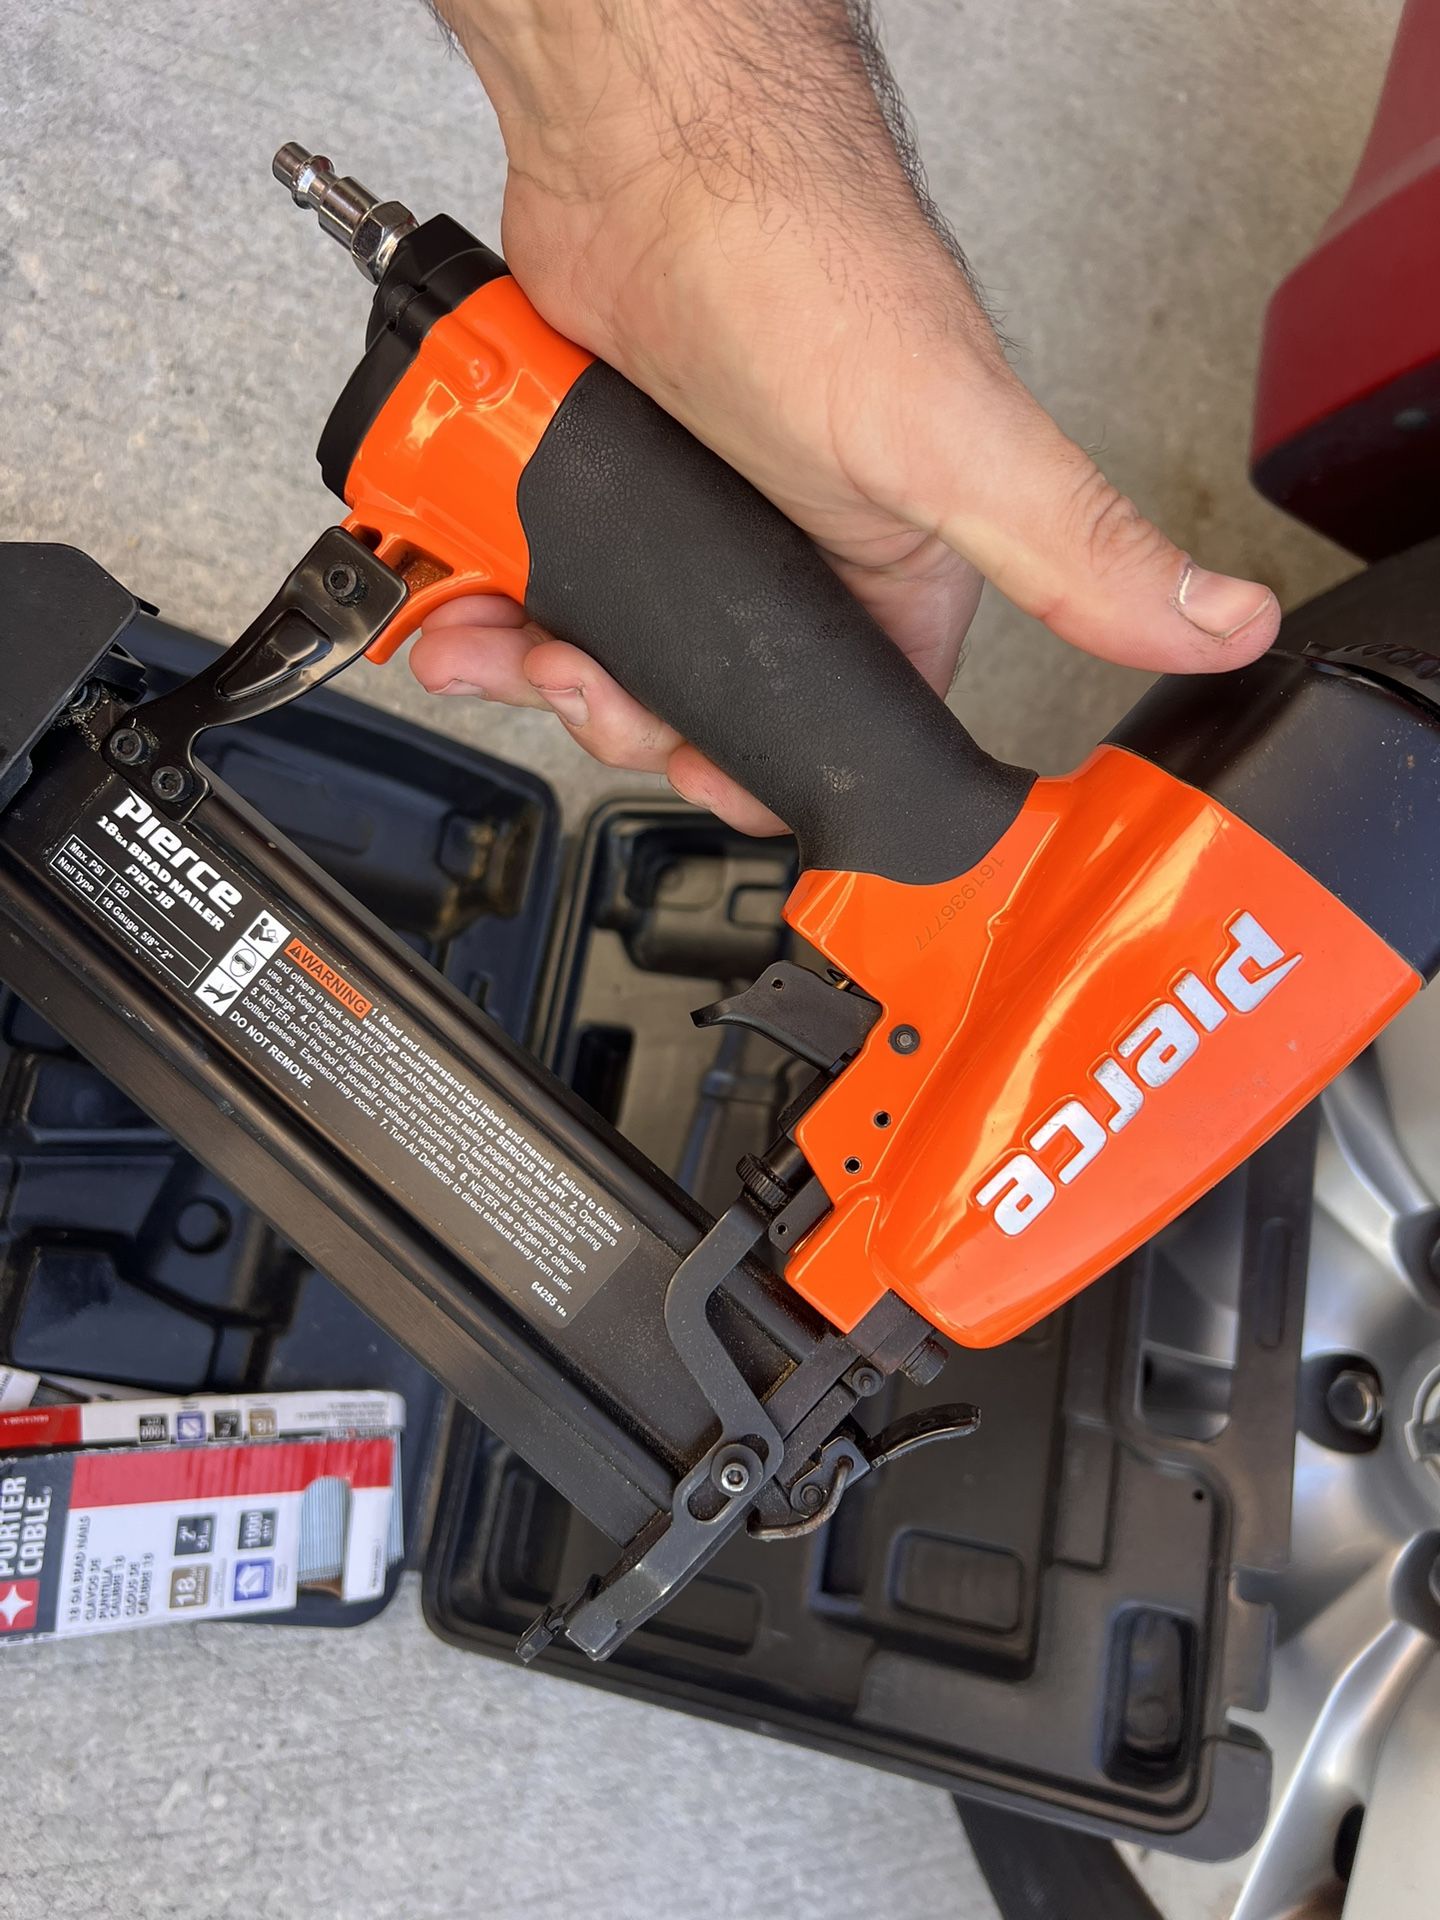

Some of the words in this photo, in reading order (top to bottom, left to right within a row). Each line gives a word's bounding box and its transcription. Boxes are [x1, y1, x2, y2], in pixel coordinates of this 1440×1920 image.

[57, 856, 77, 876] Nail
[74, 870, 95, 893] Type
[69, 842, 88, 864] Max.
[88, 859, 106, 877] PSI
[113, 788, 243, 917] Pierce
[113, 882, 130, 899] 120
[124, 863, 176, 910] PRC-18
[127, 841, 172, 883] BRAD
[168, 878, 225, 931] NAILER
[102, 896, 115, 909] 18
[112, 906, 140, 936] Gauge,
[914, 856, 1005, 951] 161936777
[297, 950, 367, 1014] WARNING
[228, 1010, 248, 1029] DO
[245, 1024, 272, 1048] NOT
[267, 1044, 314, 1089] REMOVE.
[975, 911, 1303, 1236] Pierce
[241, 995, 271, 1023] bottled
[266, 1020, 297, 1049] gasses.
[299, 1047, 338, 1084] Explosion
[335, 1080, 356, 1100] may
[353, 1096, 378, 1120] occur.
[379, 1117, 389, 1130] 7.
[389, 1124, 408, 1146] Turn
[405, 1142, 420, 1156] Air
[417, 1152, 455, 1186] Deflector
[452, 1182, 462, 1195] to
[460, 1192, 485, 1215] direct
[482, 1211, 516, 1242] exhaust
[512, 1238, 536, 1261] away
[533, 1256, 554, 1277] from
[552, 1273, 573, 1295] user.
[249, 986, 260, 998] 5.
[258, 993, 291, 1025] NEVER
[286, 1021, 311, 1042] point
[307, 1037, 323, 1053] the
[320, 1049, 339, 1067] tool
[335, 1064, 348, 1075] at
[342, 1071, 379, 1101] yourself
[375, 1098, 387, 1109] or
[384, 1106, 411, 1131] others
[408, 1126, 419, 1139] in
[417, 1135, 438, 1156] work
[436, 1153, 456, 1174] area.
[459, 1172, 469, 1184] 6.
[467, 1179, 501, 1211] NEVER
[497, 1207, 514, 1224] use
[512, 1221, 543, 1250] oxygen
[541, 1246, 553, 1257] or
[550, 1255, 574, 1276] other
[258, 978, 297, 1015] discharge.
[299, 1014, 309, 1025] 4.
[308, 1021, 337, 1049] Choice
[334, 1046, 348, 1057] of
[343, 1052, 382, 1089] triggering
[379, 1085, 412, 1114] method
[408, 1109, 418, 1121] is
[416, 1116, 455, 1154] important.
[457, 1152, 483, 1179] Check
[481, 1175, 513, 1204] manual
[509, 1199, 524, 1214] for
[521, 1210, 559, 1248] triggering
[557, 1243, 587, 1274] options.
[266, 967, 283, 986] use.
[285, 984, 295, 996] 3.
[294, 991, 317, 1014] Keep
[315, 1010, 344, 1037] fingers
[340, 1033, 370, 1057] AWAY
[365, 1054, 386, 1075] from
[383, 1070, 411, 1096] trigger
[408, 1093, 432, 1116] when
[429, 1112, 446, 1128] not
[443, 1124, 471, 1152] driving
[469, 1146, 506, 1182] fasteners
[504, 1177, 515, 1189] to
[513, 1187, 538, 1209] avoid
[534, 1206, 577, 1243] accidental
[274, 958, 294, 975] and
[290, 972, 316, 996] others
[314, 991, 325, 1004] in
[323, 1000, 344, 1021] work
[341, 1017, 362, 1037] area
[359, 1032, 389, 1058] MUST
[385, 1055, 407, 1075] wear
[403, 1072, 465, 1126] ANSI-approved
[461, 1122, 487, 1147] safety
[483, 1144, 517, 1174] goggles
[515, 1170, 533, 1189] with
[531, 1185, 550, 1204] side
[548, 1200, 578, 1228] shields
[576, 1225, 602, 1252] during
[361, 1017, 401, 1054] warnings
[399, 1051, 426, 1075] could
[422, 1071, 450, 1096] result
[446, 1091, 458, 1104] in
[455, 1099, 489, 1130] DEATH
[485, 1127, 498, 1138] or
[495, 1135, 537, 1173] SERIOUS
[533, 1168, 569, 1203] INJURY.
[568, 1200, 579, 1213] 2.
[578, 1209, 618, 1247] Operators
[371, 1007, 379, 1019] 1.
[378, 1014, 404, 1038] Read
[400, 1035, 421, 1053] and
[417, 1049, 467, 1093] understand
[463, 1089, 484, 1108] tool
[479, 1103, 507, 1130] labels
[505, 1127, 525, 1145] and
[521, 1141, 555, 1174] manual.
[556, 1171, 587, 1201] Failure
[585, 1197, 597, 1210] to
[594, 1206, 623, 1233] follow
[530, 1280, 558, 1307] 64255
[175, 1576, 197, 1606] 18
